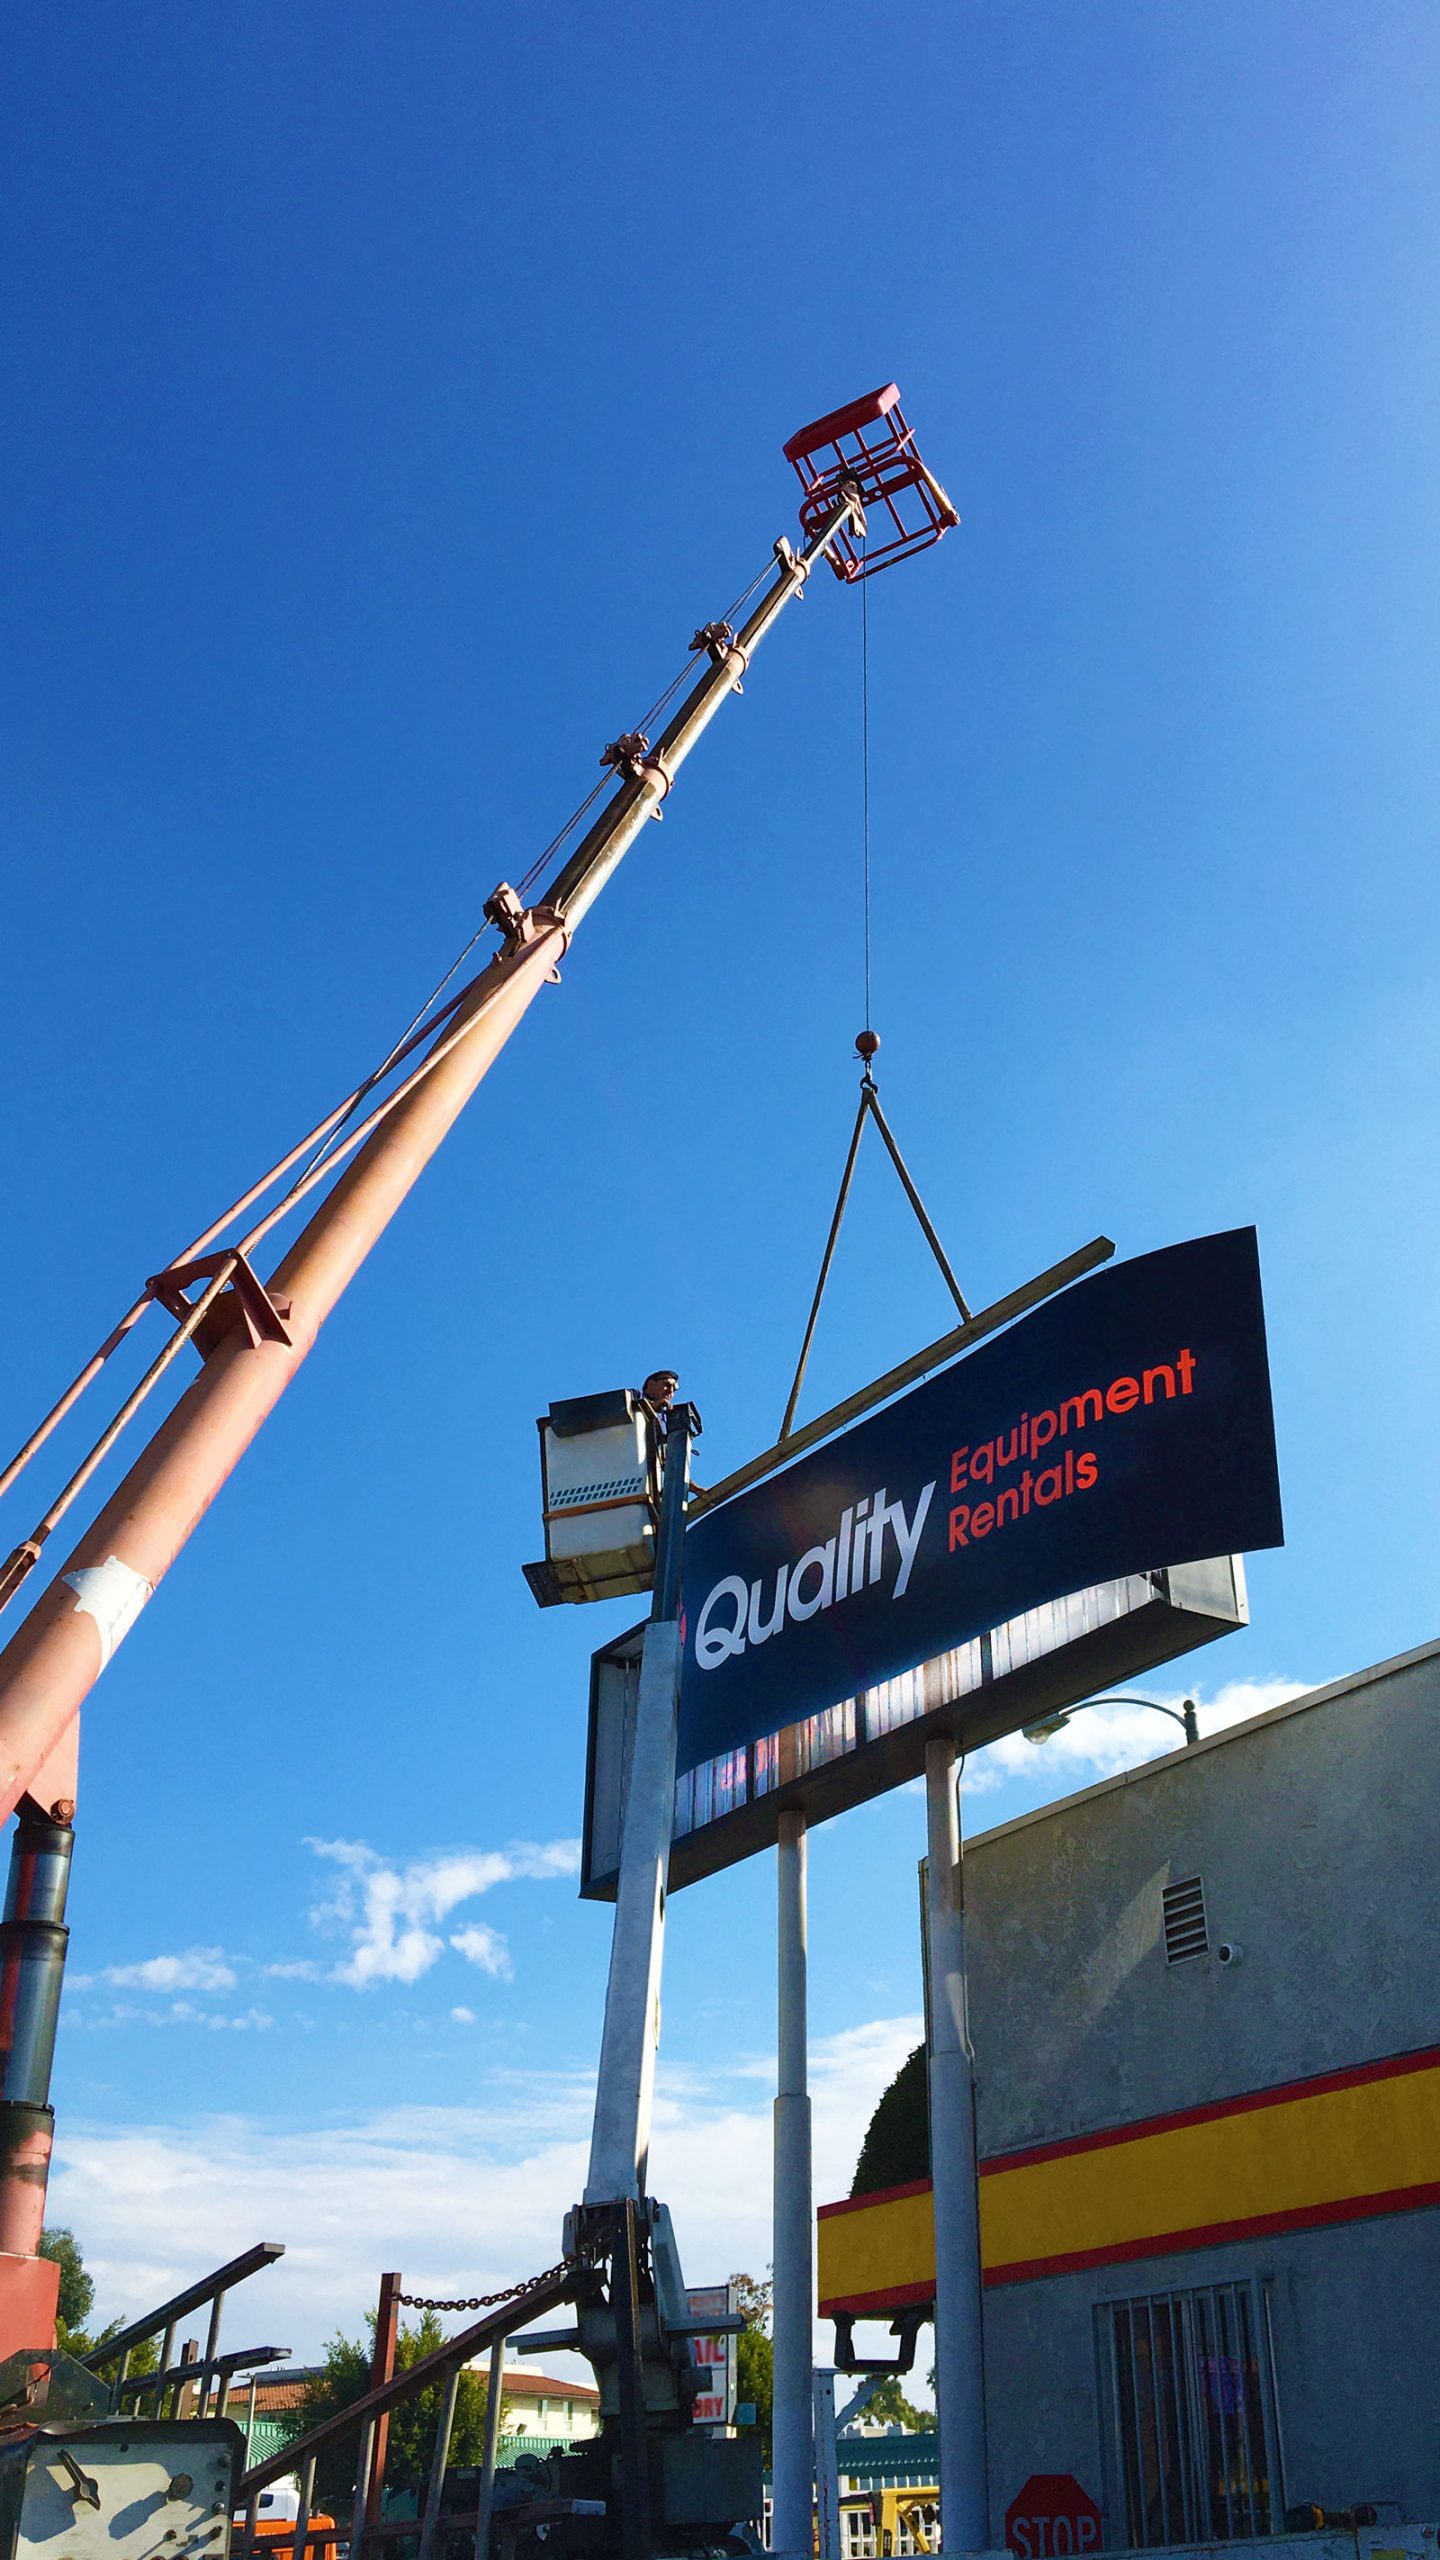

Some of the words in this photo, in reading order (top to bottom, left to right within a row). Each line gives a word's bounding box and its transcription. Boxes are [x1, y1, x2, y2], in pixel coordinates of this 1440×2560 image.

[951, 1348, 1197, 1494] Equipment
[949, 1449, 1099, 1552] Rentals
[695, 1480, 937, 1671] Quality
[1012, 2515, 1097, 2560] STOP
